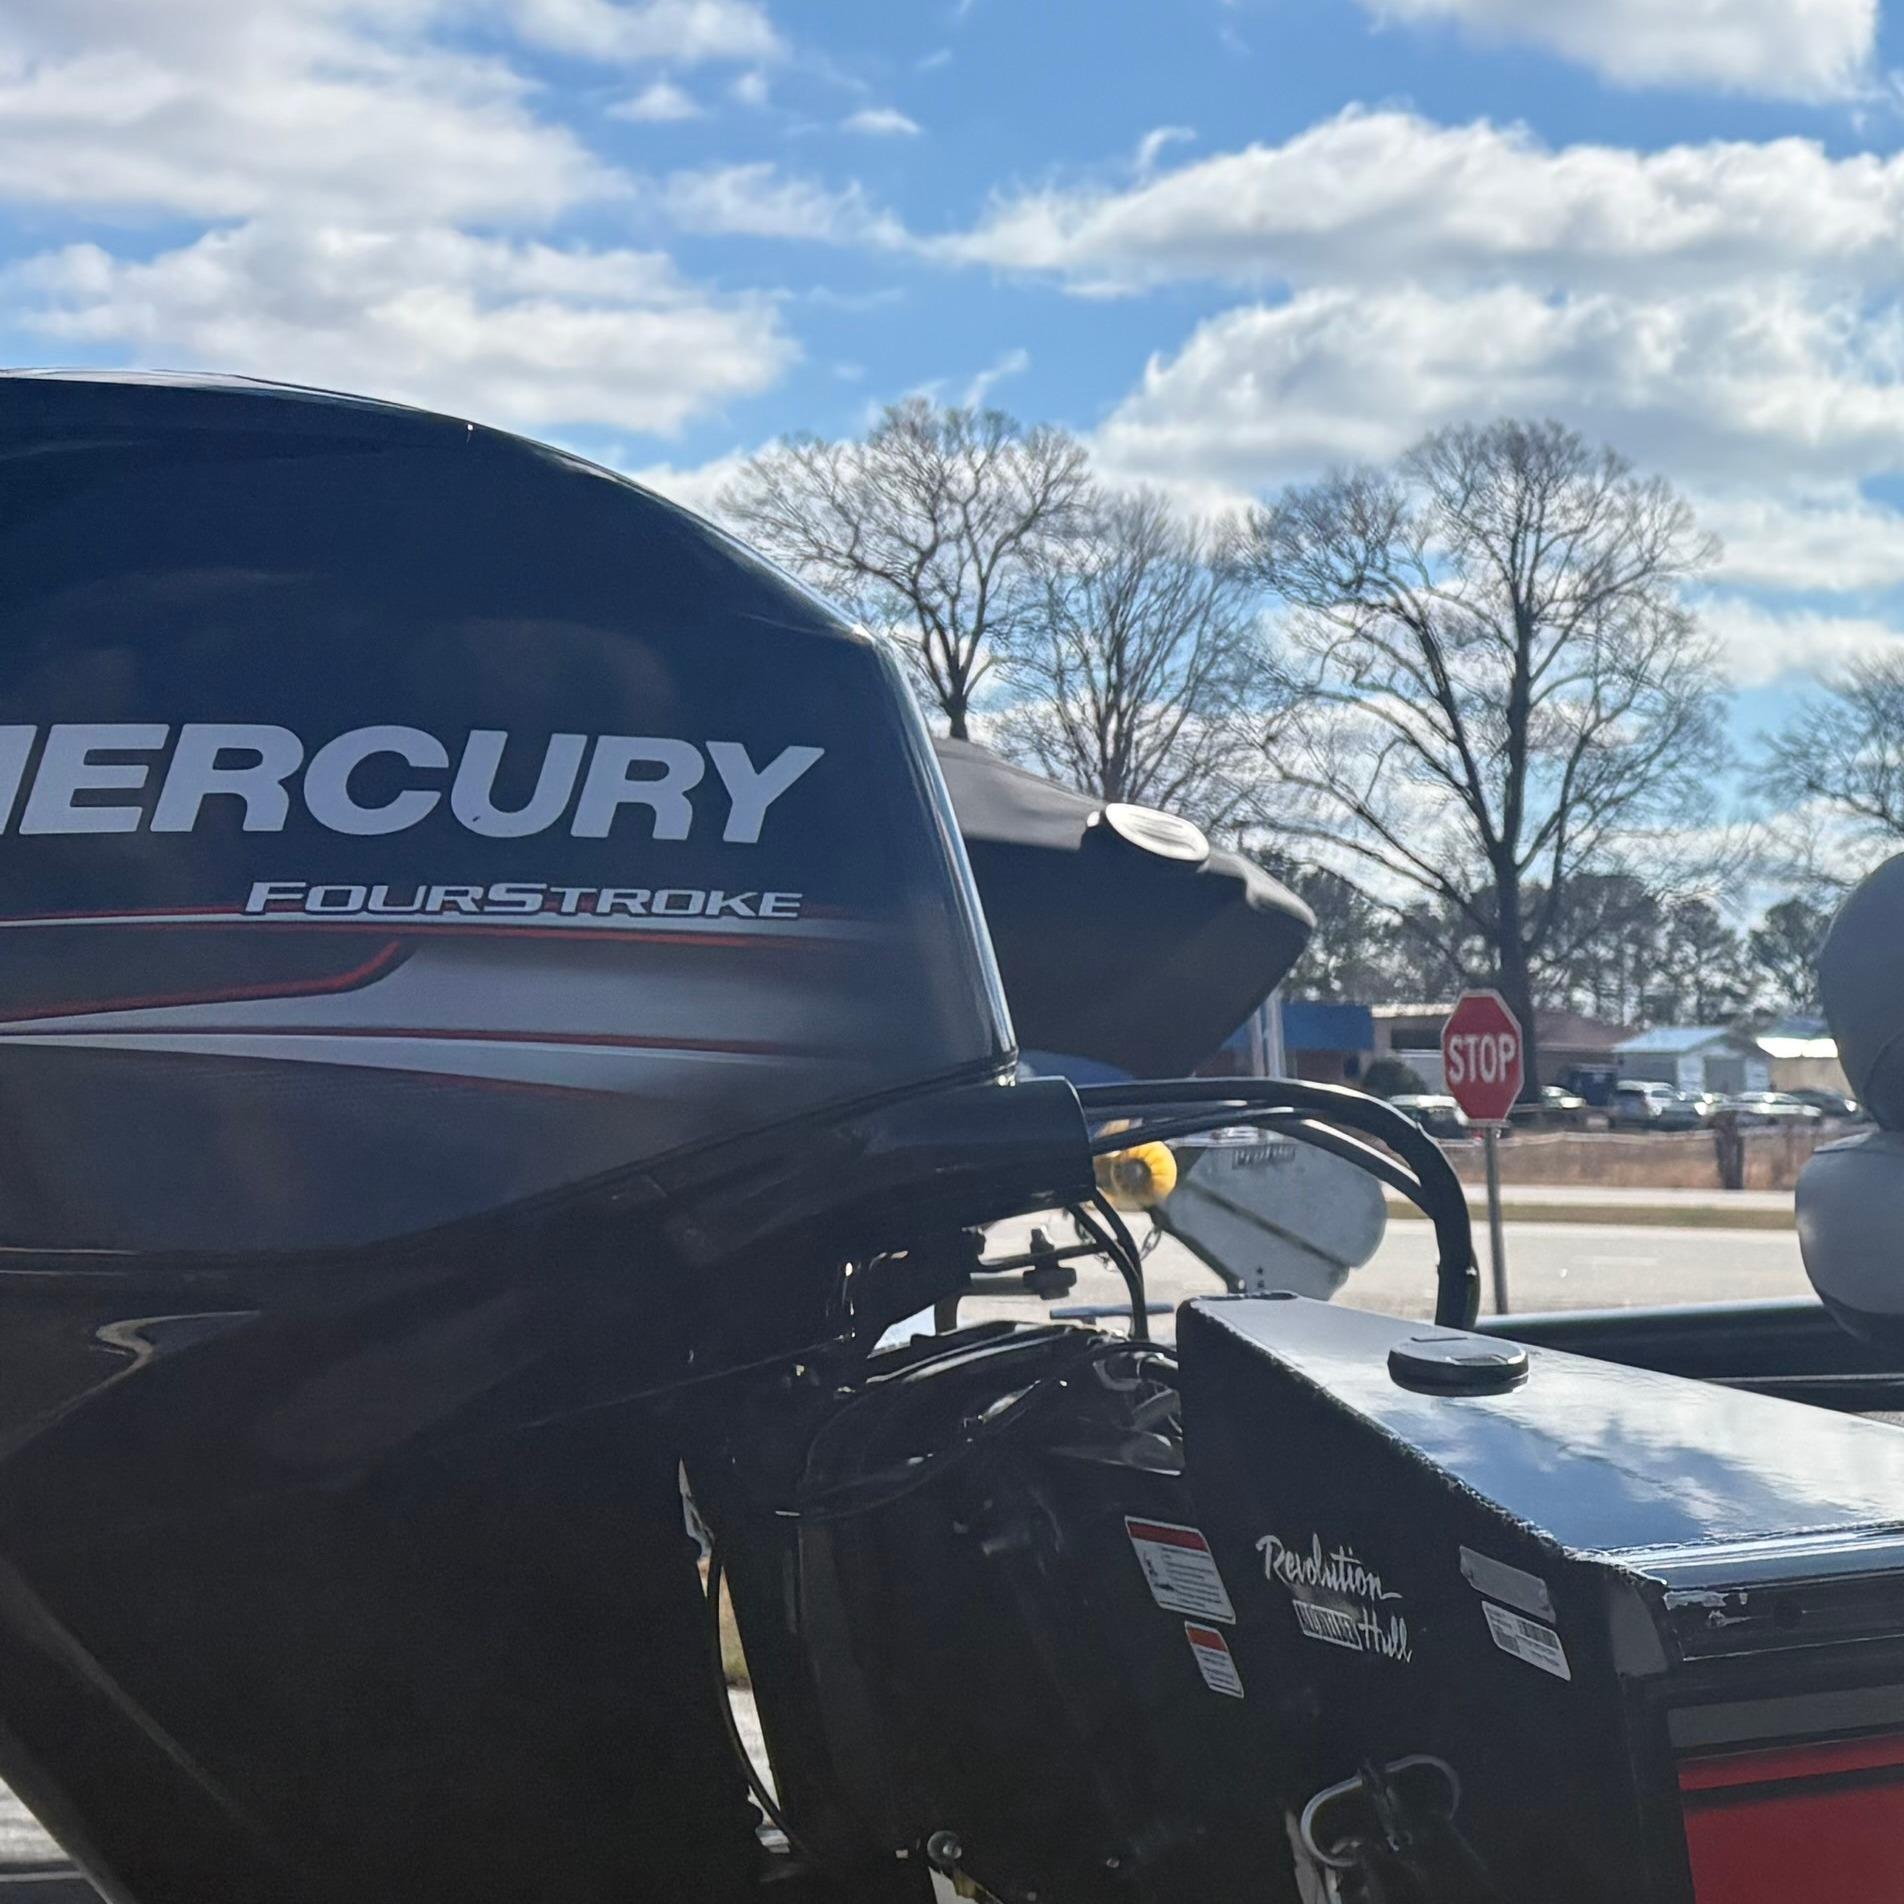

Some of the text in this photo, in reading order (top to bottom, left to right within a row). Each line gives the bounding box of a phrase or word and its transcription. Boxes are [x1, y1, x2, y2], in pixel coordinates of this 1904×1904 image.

[1448, 1033, 1517, 1084] STOP
[1255, 1532, 1402, 1602] Revolution
[1358, 1605, 1412, 1663] Hull
